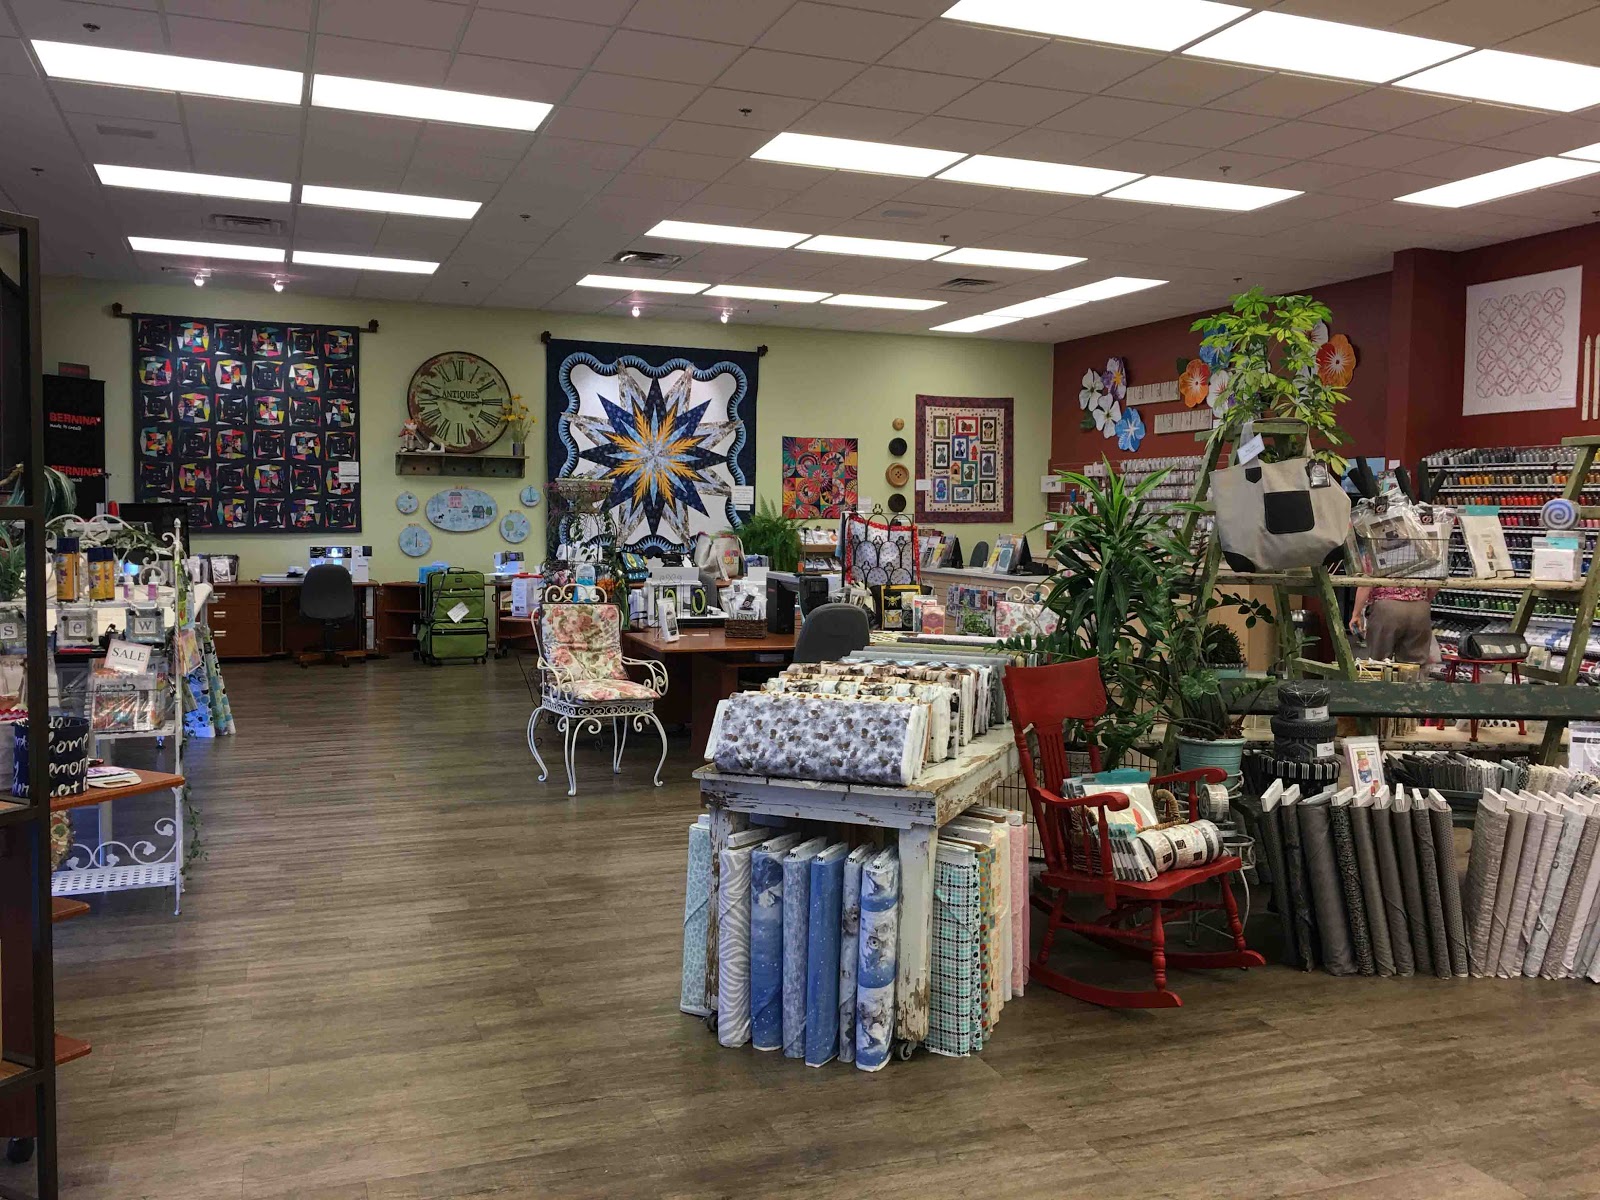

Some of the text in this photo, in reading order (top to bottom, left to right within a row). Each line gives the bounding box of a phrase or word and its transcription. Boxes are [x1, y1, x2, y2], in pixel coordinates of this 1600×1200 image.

[441, 390, 479, 400] ANTIQUES
[49, 412, 97, 425] BERNINA
[73, 622, 82, 633] e
[111, 646, 146, 662] SALE
